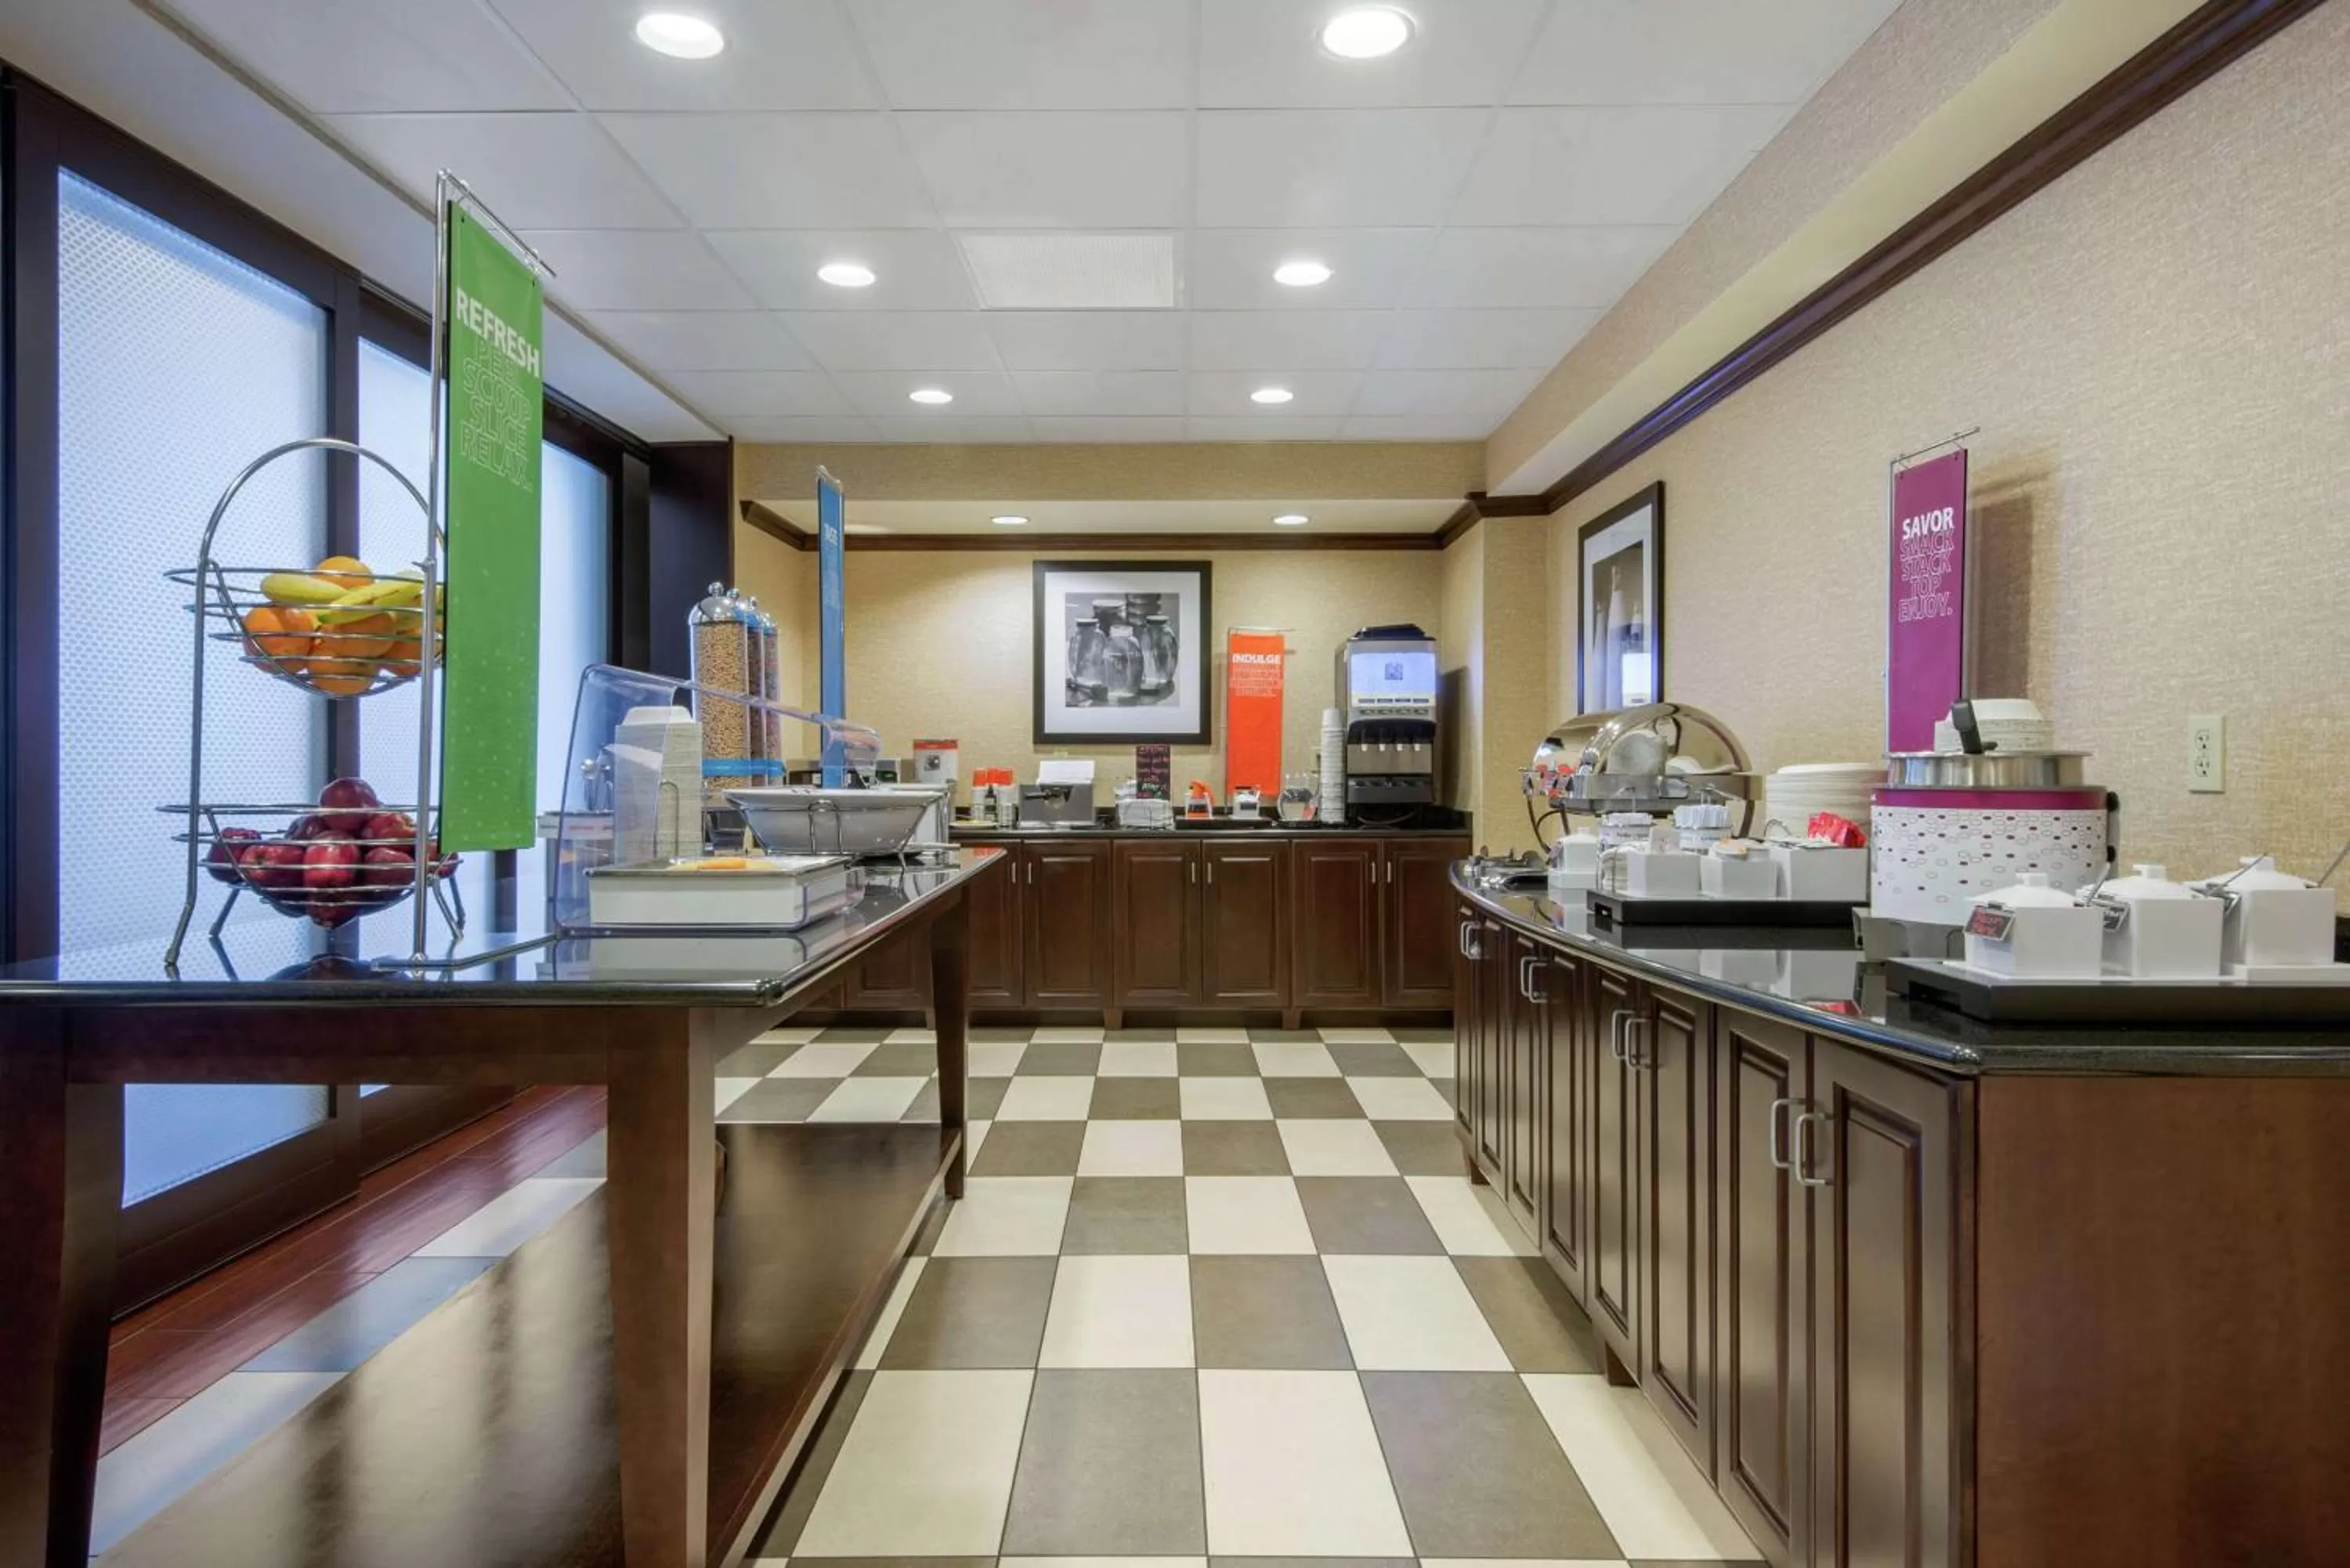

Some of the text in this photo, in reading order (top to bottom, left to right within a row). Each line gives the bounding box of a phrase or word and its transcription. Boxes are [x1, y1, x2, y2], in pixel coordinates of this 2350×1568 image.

[457, 287, 539, 378] REFRESH
[464, 357, 532, 422] SCOOP
[470, 395, 527, 461] SLICE
[1902, 508, 1954, 540] SAVOR
[1901, 550, 1952, 581] STACK
[1910, 574, 1942, 598] TOP
[1898, 591, 1954, 623] ENJOY.
[1232, 653, 1282, 664] INDULGE
